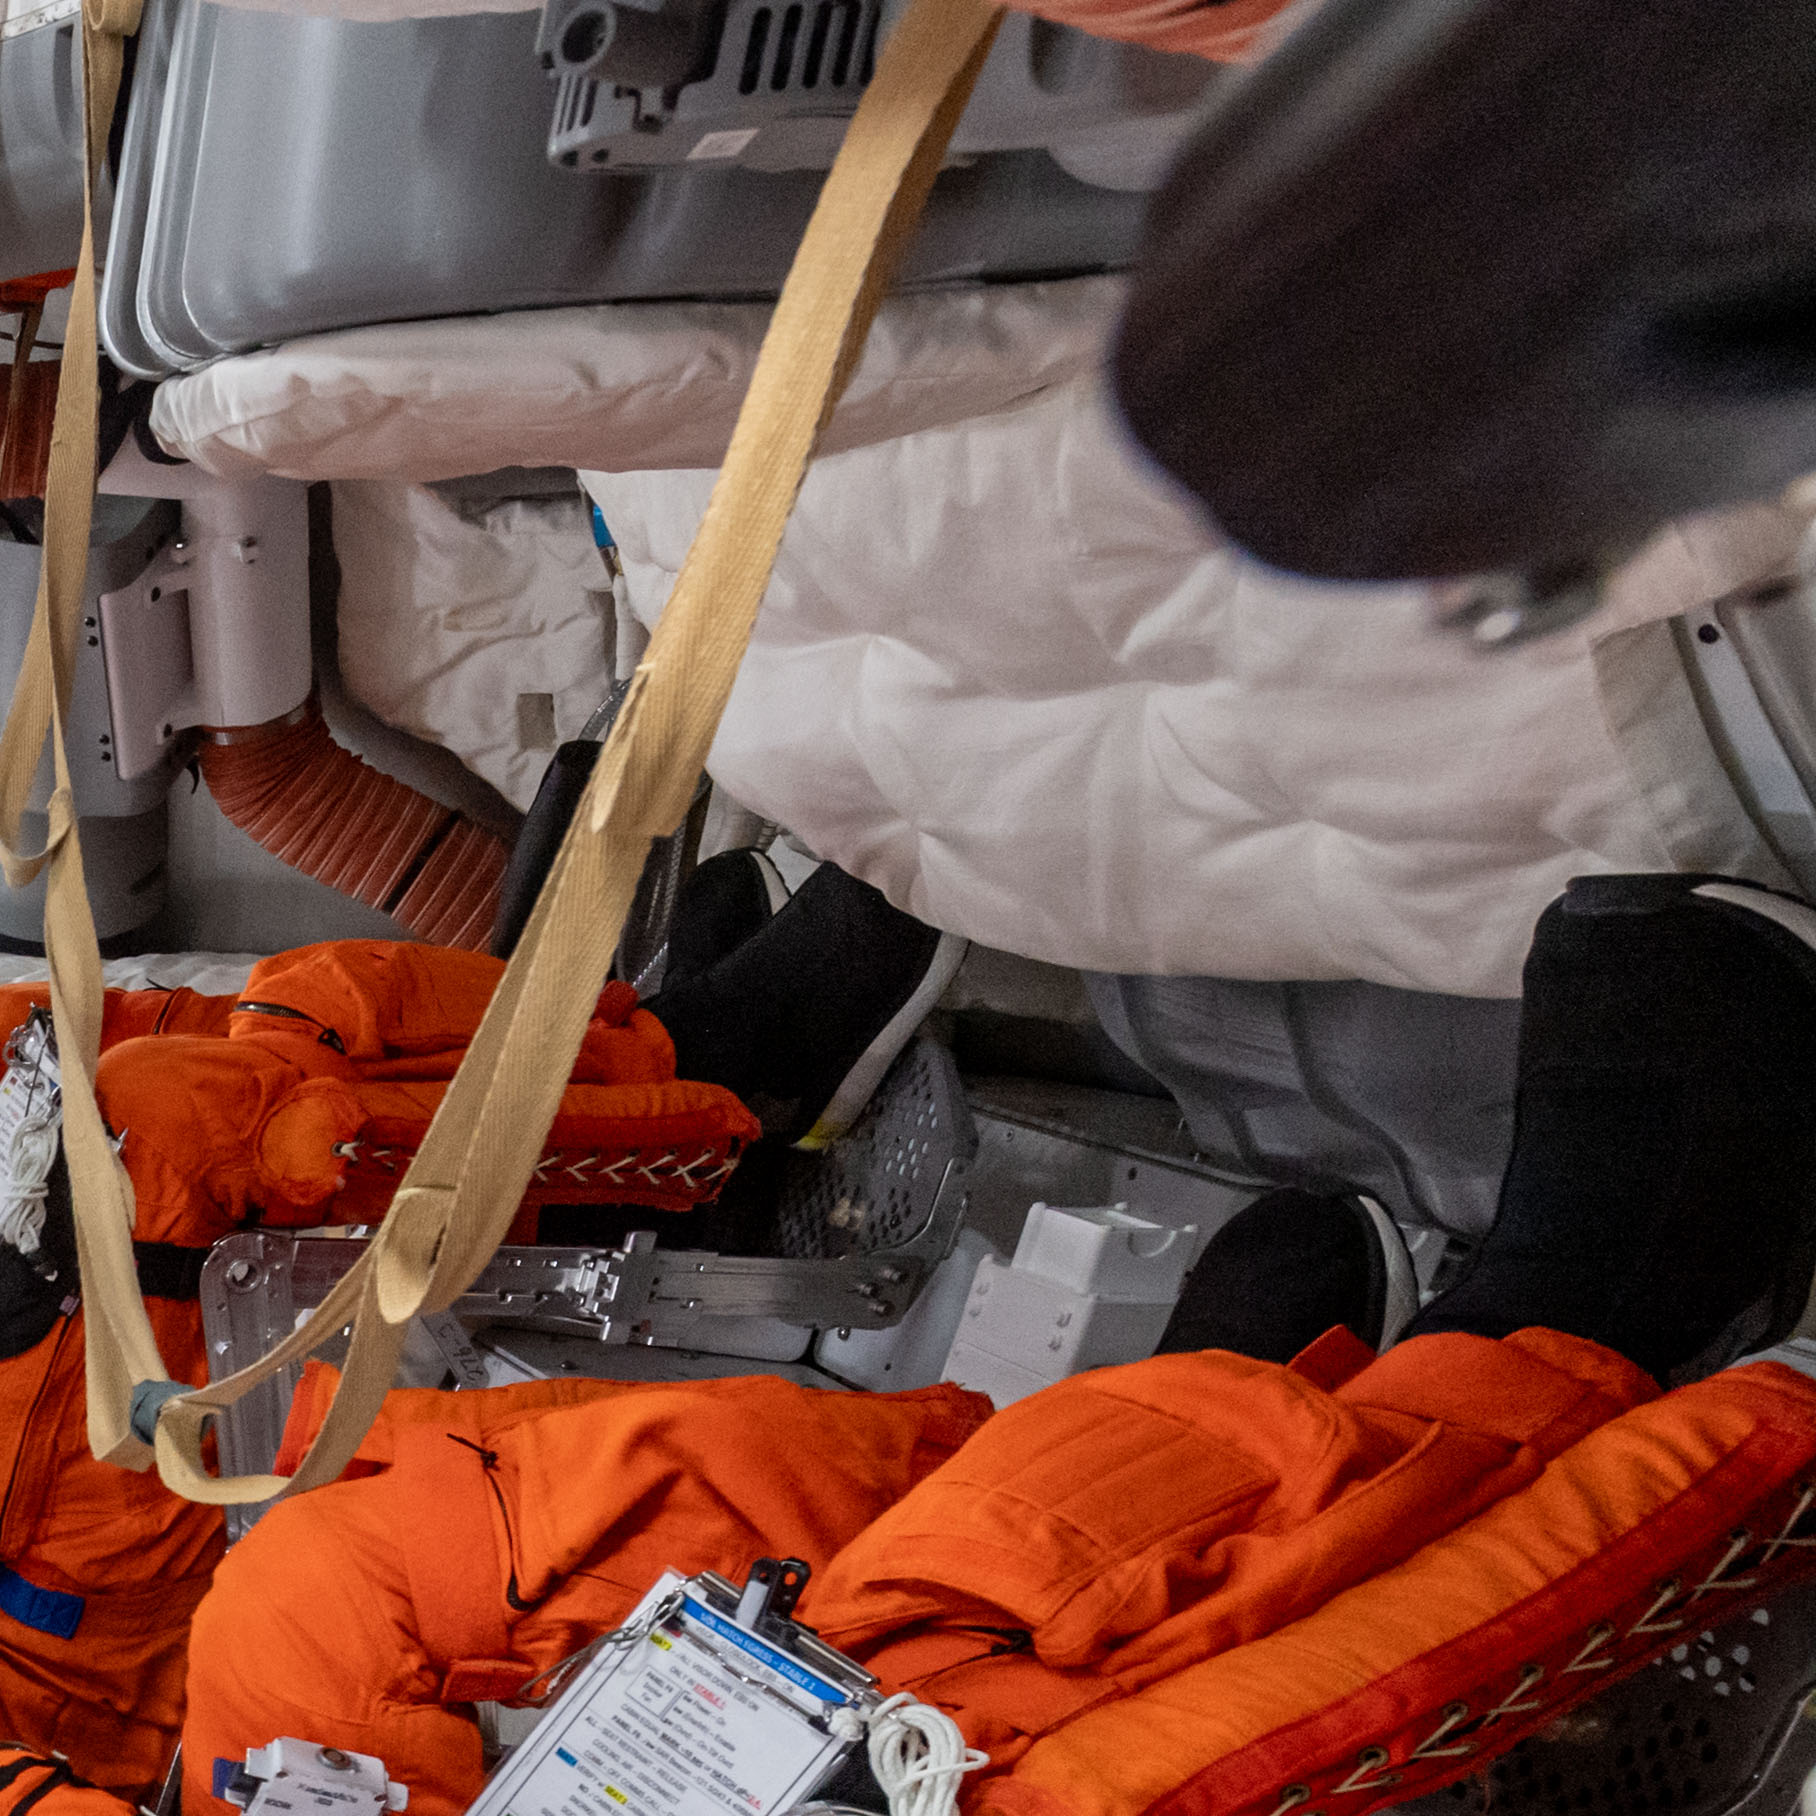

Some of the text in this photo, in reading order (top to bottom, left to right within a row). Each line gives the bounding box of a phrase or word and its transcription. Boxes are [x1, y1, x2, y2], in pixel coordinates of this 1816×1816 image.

[715, 1623, 745, 1646] HATCH
[742, 1639, 774, 1664] EGRESS
[777, 1661, 809, 1687] STABLE
[692, 1681, 722, 1706] STABLE
[611, 1713, 633, 1733] PANEL
[659, 1731, 681, 1751] MARK
[636, 1770, 680, 1807] DISCONNECT
[655, 1767, 688, 1794] RELEASE
